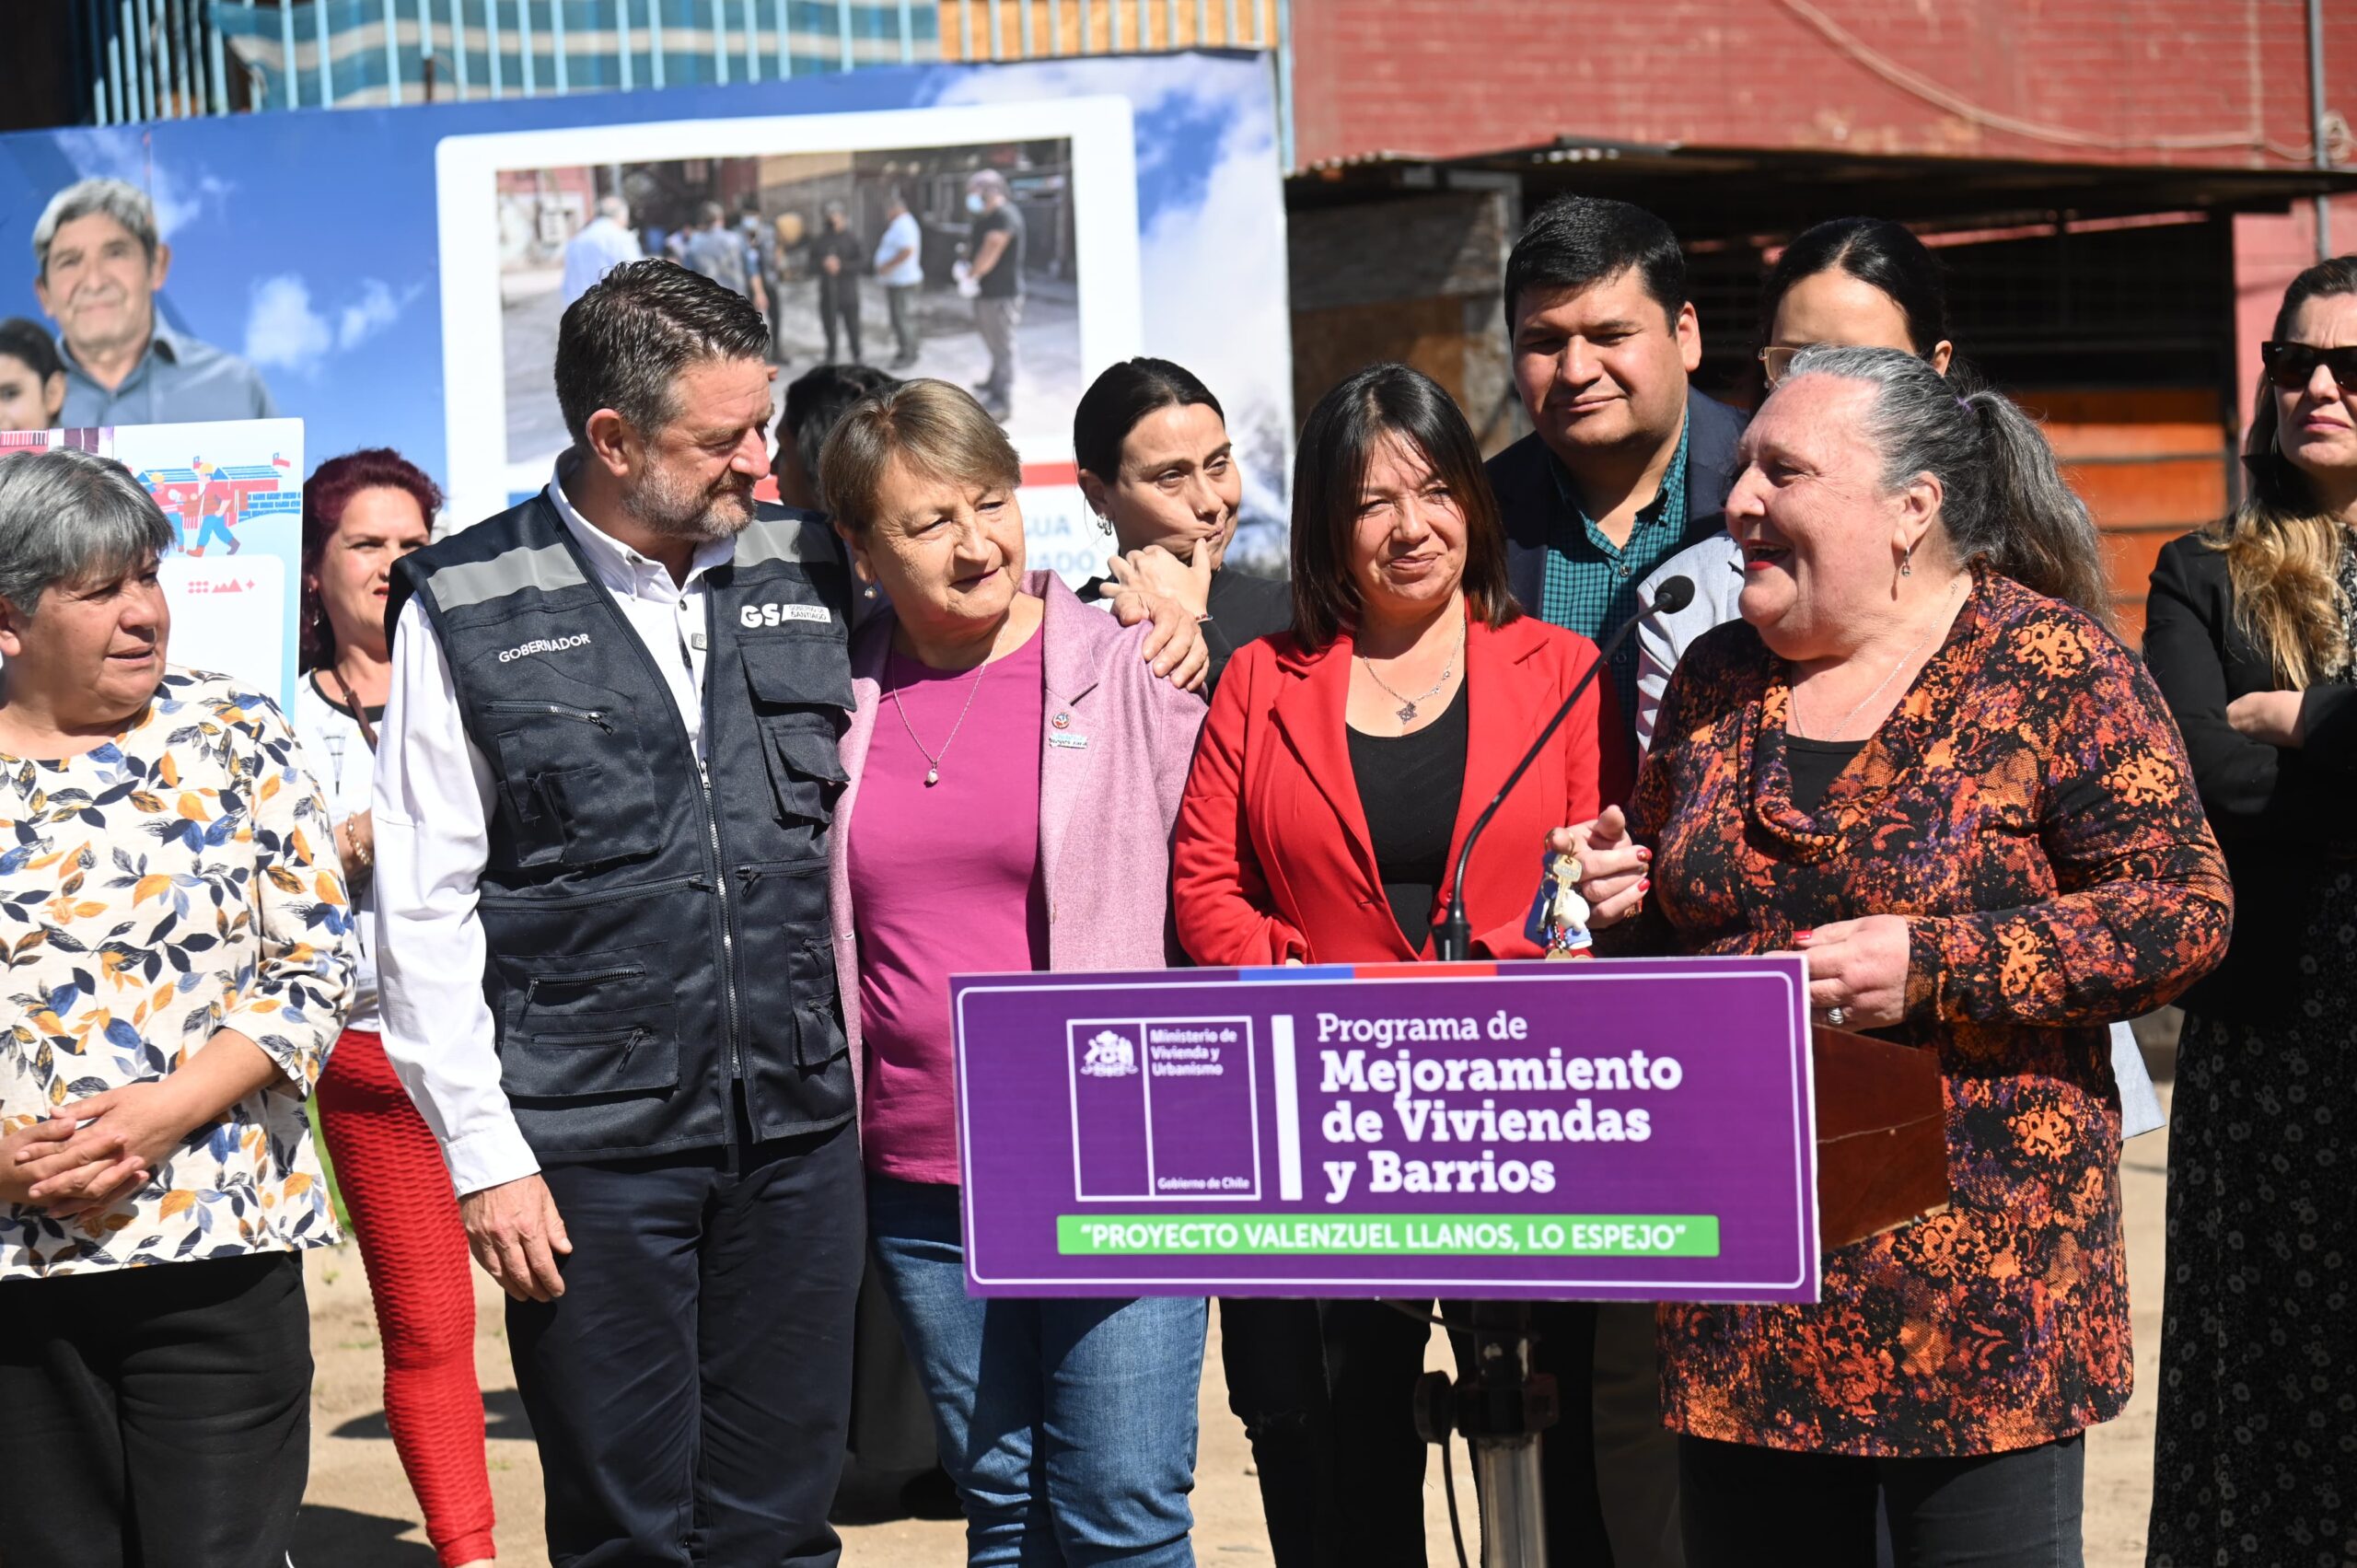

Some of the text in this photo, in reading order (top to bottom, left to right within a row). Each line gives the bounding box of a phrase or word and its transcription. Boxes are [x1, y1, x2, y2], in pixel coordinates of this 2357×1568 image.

[740, 603, 781, 628] GS
[791, 610, 827, 621] SANTIAGO
[499, 633, 591, 662] GOBERNADOR
[1150, 1028, 1237, 1043] Ministerio de
[1317, 1010, 1528, 1049] Programa de
[1150, 1045, 1221, 1063] Vivienda y
[1152, 1061, 1224, 1076] Urbanismo
[1319, 1047, 1683, 1101] Mejoramiento
[1322, 1098, 1652, 1143] de Viviendas
[1157, 1176, 1250, 1190] Gobierno de Chile
[1323, 1149, 1557, 1203] y Barrios
[1242, 1223, 1400, 1250] VALENZUEL
[1405, 1224, 1520, 1253] LLANOS,
[1527, 1224, 1565, 1250] LO
